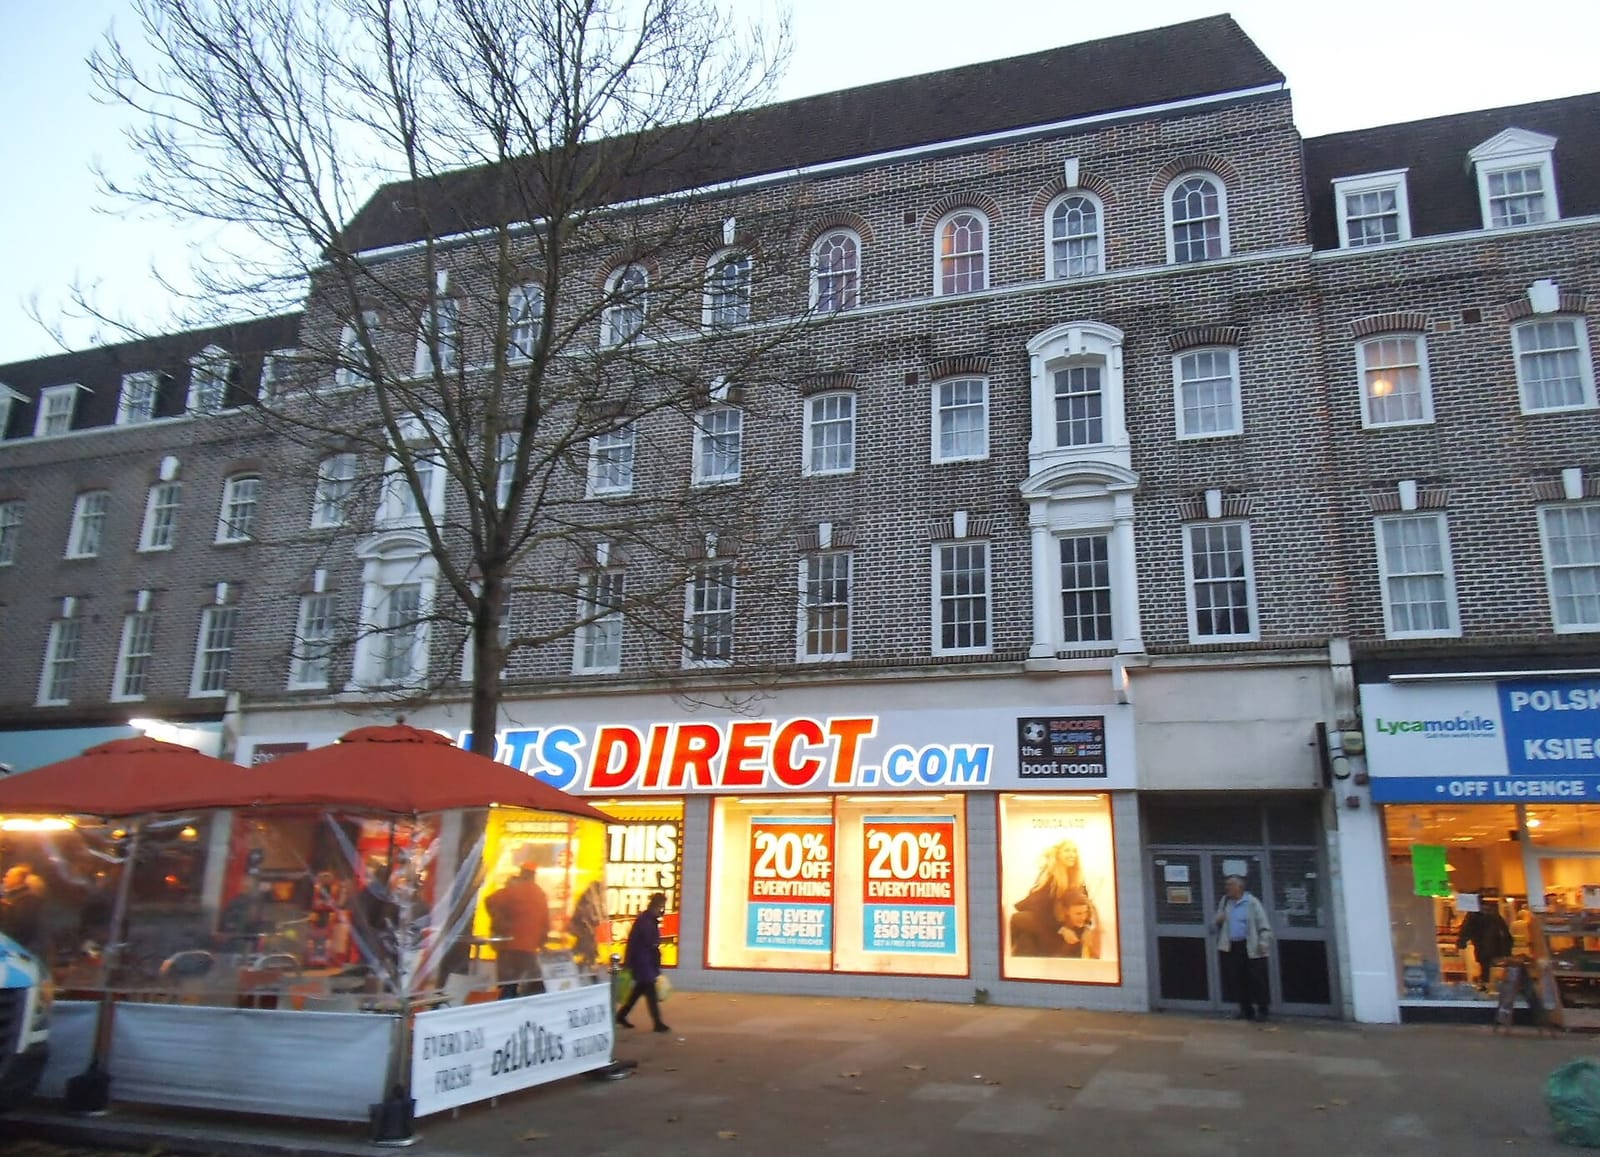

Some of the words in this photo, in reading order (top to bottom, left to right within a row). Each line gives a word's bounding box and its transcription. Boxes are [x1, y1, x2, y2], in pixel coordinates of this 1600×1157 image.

[1376, 716, 1495, 736] Lycamobile
[1022, 745, 1042, 756] the
[1021, 761, 1059, 775] boot
[1061, 763, 1104, 775] room
[1448, 781, 1488, 797] OFF
[1494, 780, 1586, 796] LICENCE
[607, 825, 677, 862] THIS
[753, 830, 829, 879] 20%
[866, 830, 947, 879] 20%
[801, 861, 832, 879] OFF
[918, 861, 951, 879] OFF
[753, 880, 832, 897] EVERYTHING
[868, 881, 951, 898] EVERYTHING
[757, 908, 783, 922] FOR
[783, 908, 825, 923] EVERY
[873, 909, 900, 924] FOR
[901, 910, 945, 925] EVERY
[782, 923, 825, 938] SPENT
[873, 924, 900, 939] £50
[901, 925, 946, 940] SPENT
